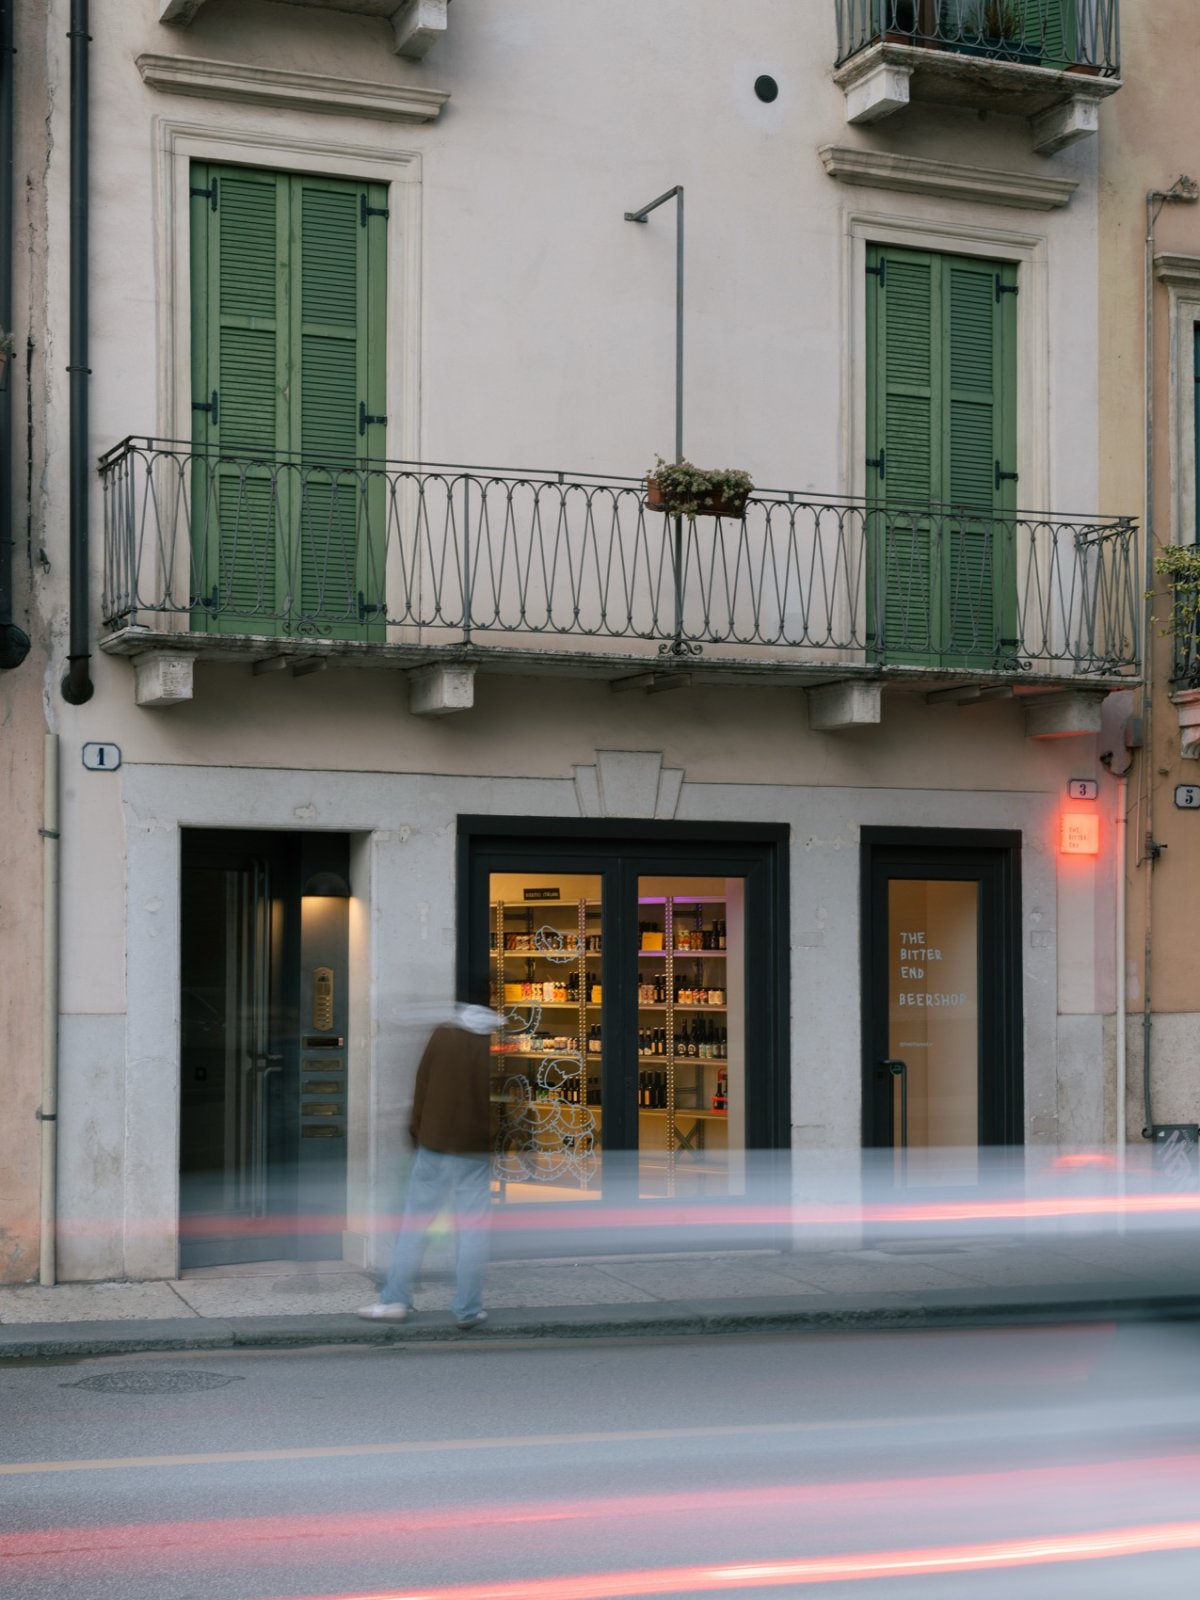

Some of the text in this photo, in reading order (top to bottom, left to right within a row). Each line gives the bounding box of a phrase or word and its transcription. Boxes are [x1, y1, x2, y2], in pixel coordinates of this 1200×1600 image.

[97, 747, 106, 766] 1
[1079, 783, 1087, 797] 3
[1185, 789, 1194, 804] 5
[900, 932, 926, 944] THE
[900, 948, 943, 961] BITTER
[900, 966, 925, 979] END
[899, 993, 967, 1007] BEERSHOP
